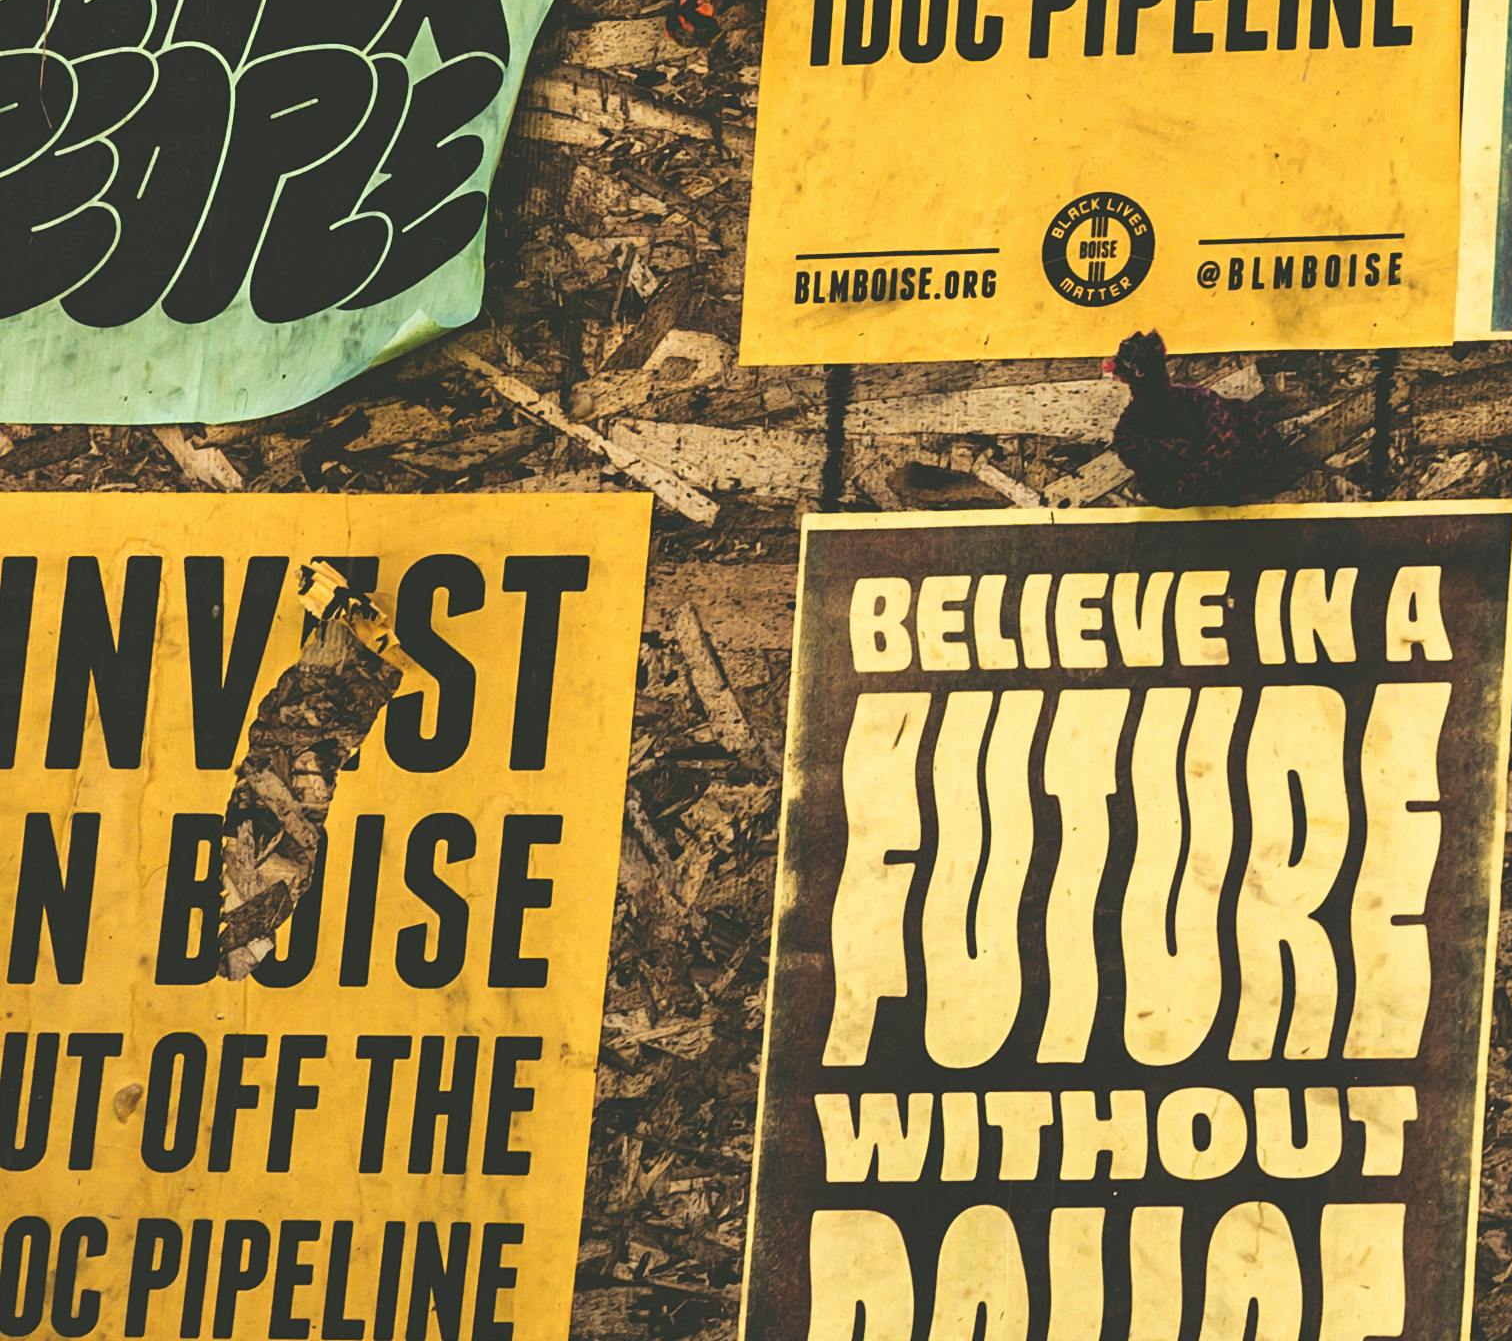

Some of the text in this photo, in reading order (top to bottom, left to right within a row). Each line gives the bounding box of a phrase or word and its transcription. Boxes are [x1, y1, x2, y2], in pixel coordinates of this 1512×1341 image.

[1051, 197, 1148, 239] BLACK LIVES
[1079, 239, 1118, 260] BOISE
[795, 268, 996, 304] BLMBOISE.ORG
[1059, 275, 1132, 301] MATTER
[1197, 253, 1402, 290] @BLMBOISE
[850, 566, 1452, 672] BELIEVE IN A
[822, 683, 1451, 1068] FUTURE
[141, 1032, 328, 1174] OFF
[356, 1035, 543, 1176] THE
[815, 1086, 1417, 1182] WITHOUT
[124, 1217, 525, 1341] PIPELINE
